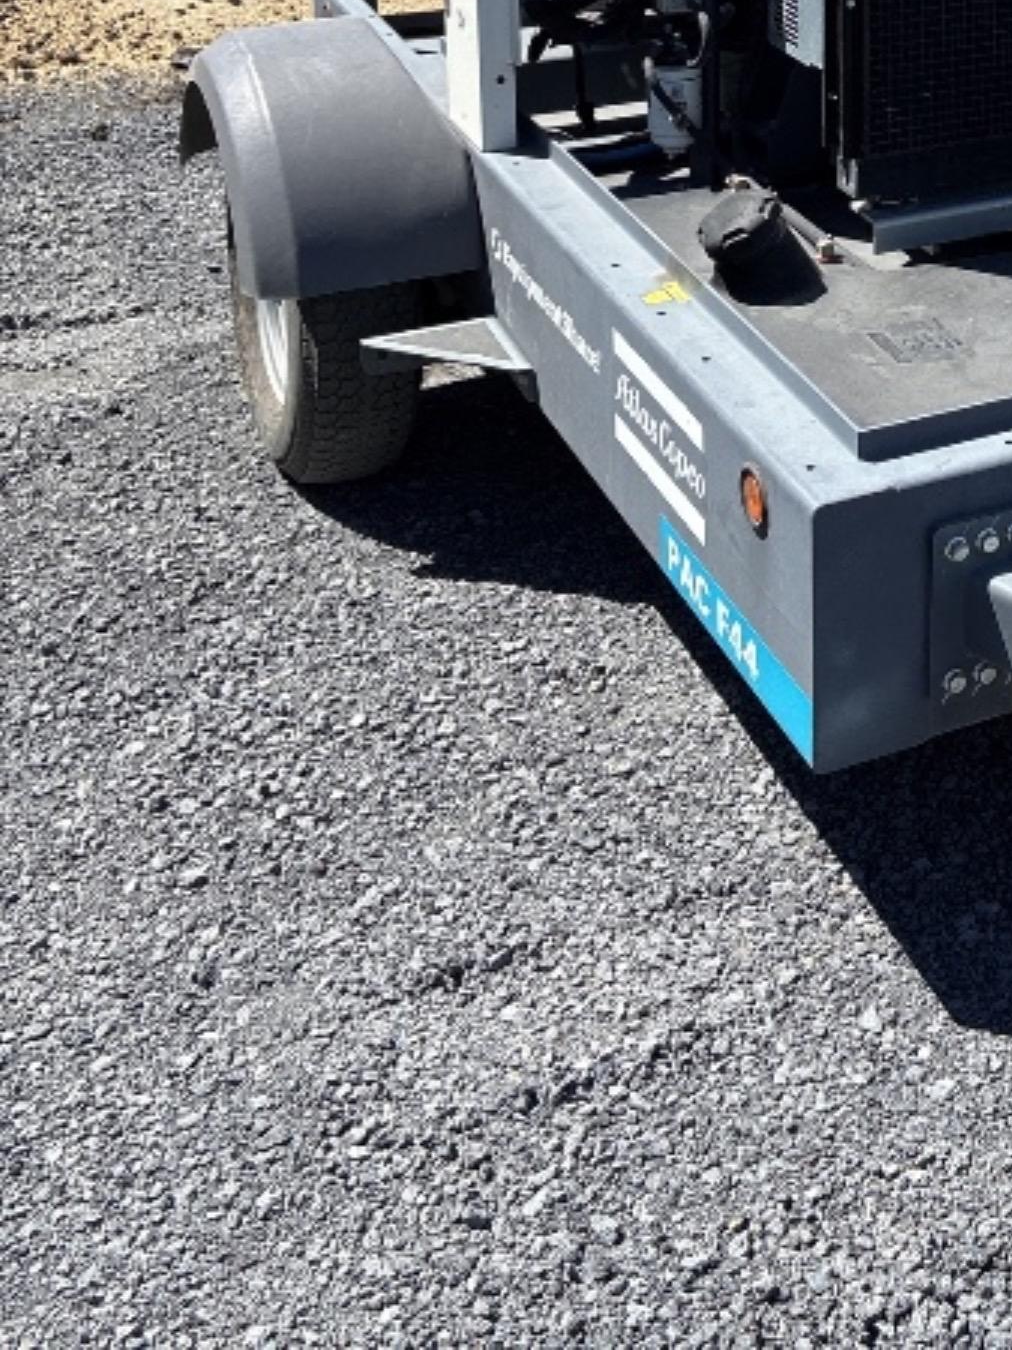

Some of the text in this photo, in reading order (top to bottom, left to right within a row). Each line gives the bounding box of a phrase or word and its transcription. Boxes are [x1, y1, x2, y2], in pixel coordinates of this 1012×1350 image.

[614, 373, 707, 500] Atlas Copco
[667, 535, 760, 680] PAC F44
